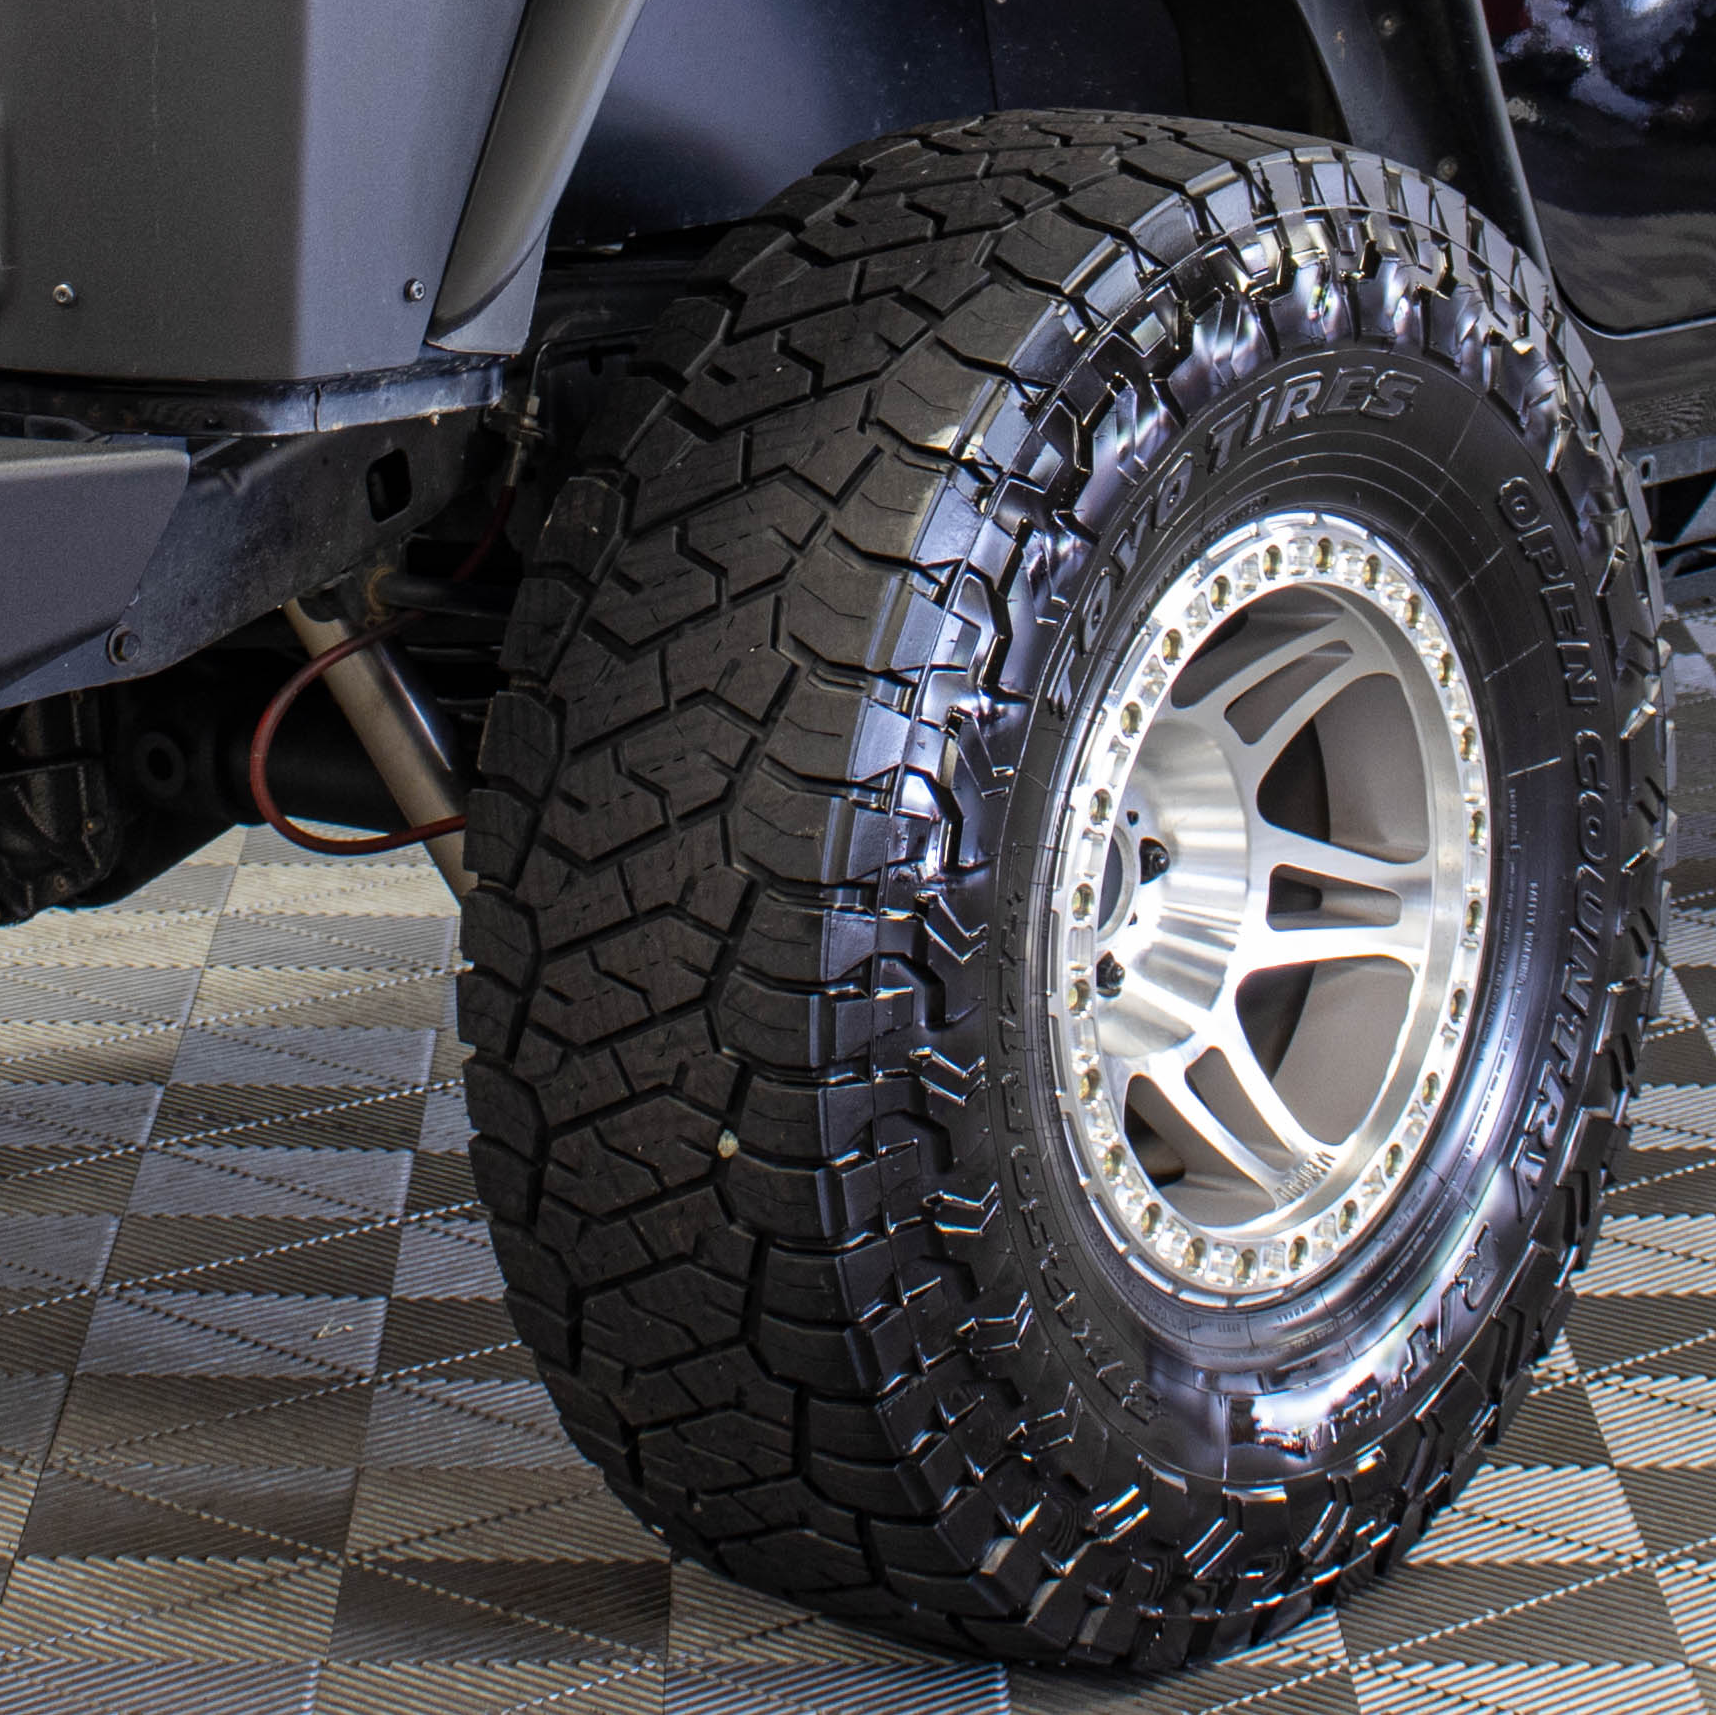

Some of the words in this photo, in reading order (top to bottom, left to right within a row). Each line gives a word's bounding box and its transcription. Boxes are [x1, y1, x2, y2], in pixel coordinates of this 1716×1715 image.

[1046, 449, 1194, 720] TOYO
[1204, 366, 1423, 476] TIRES
[1496, 474, 1602, 709] OPEN
[1510, 728, 1610, 1225] COUNTRY
